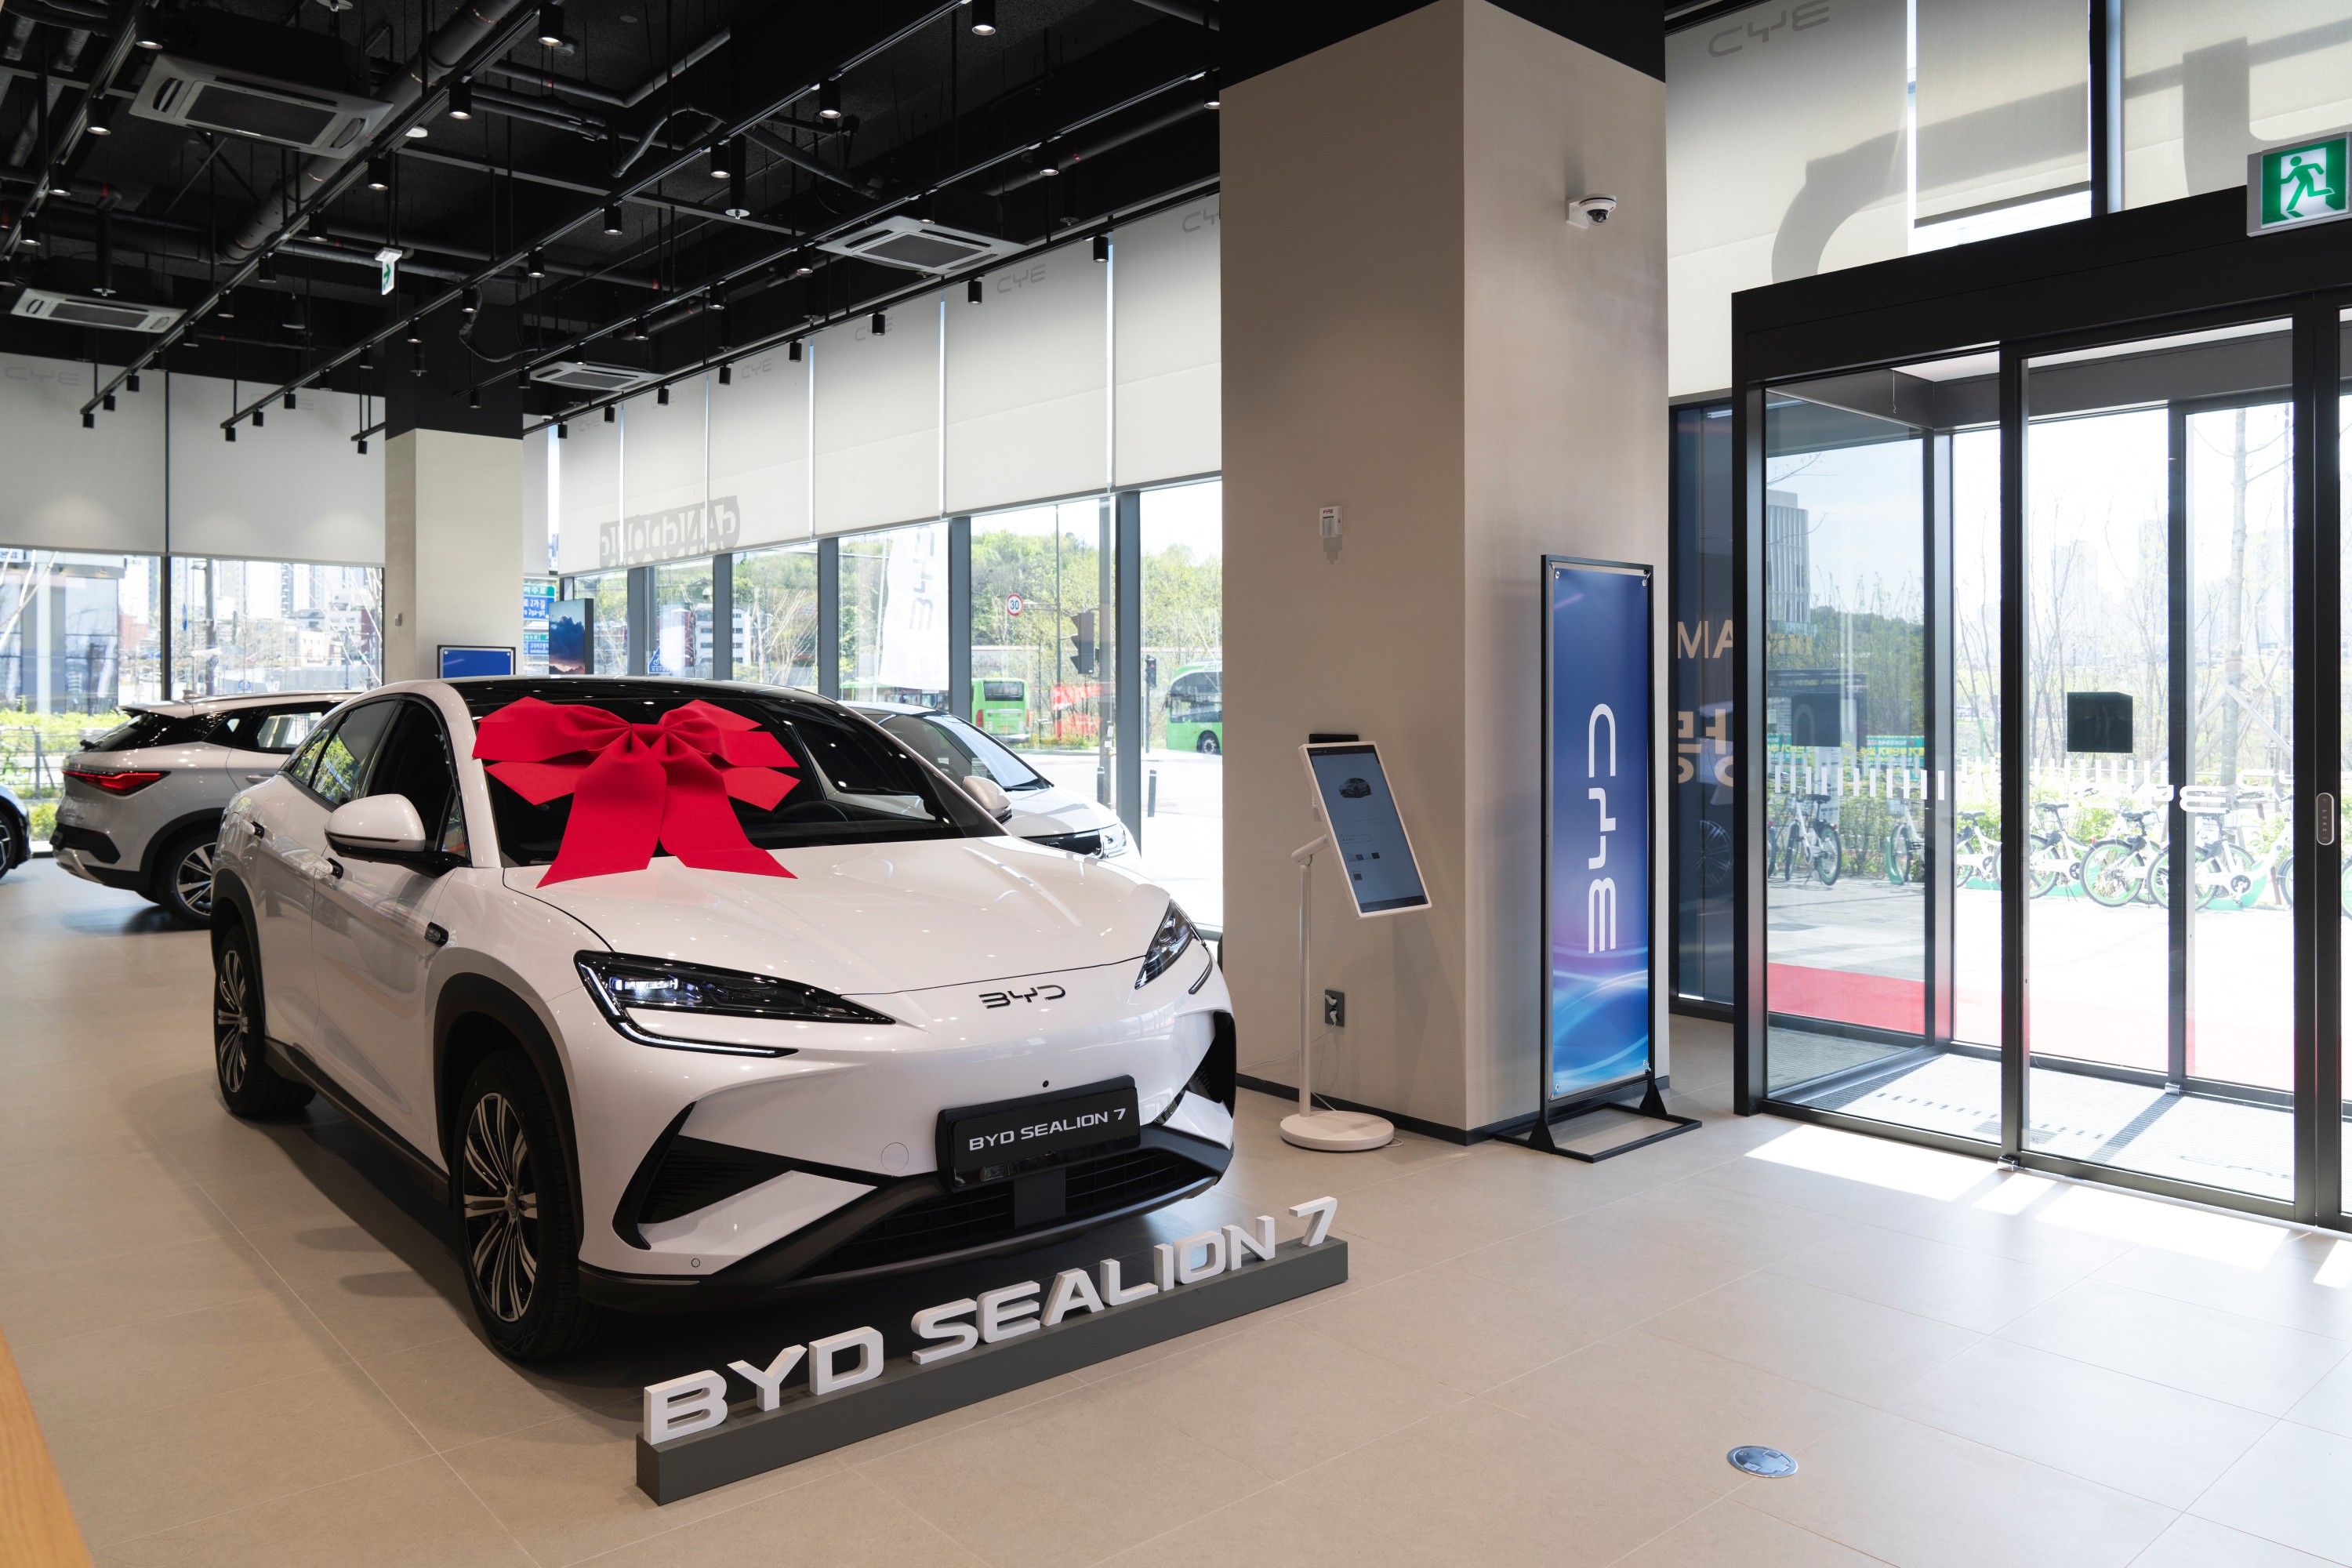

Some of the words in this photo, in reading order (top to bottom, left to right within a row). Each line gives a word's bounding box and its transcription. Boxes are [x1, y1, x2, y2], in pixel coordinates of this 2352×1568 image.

[524, 586, 547, 595] 리수로
[1010, 600, 1020, 610] 30
[1587, 702, 1617, 955] BYD
[978, 984, 1066, 1010] BYD
[969, 1131, 1014, 1152] BYD
[1021, 1111, 1109, 1141] SEALION
[1113, 1108, 1127, 1121] 7
[644, 1325, 884, 1445] BYD
[911, 1215, 1276, 1366] SEALION
[1288, 1196, 1338, 1247] 7
